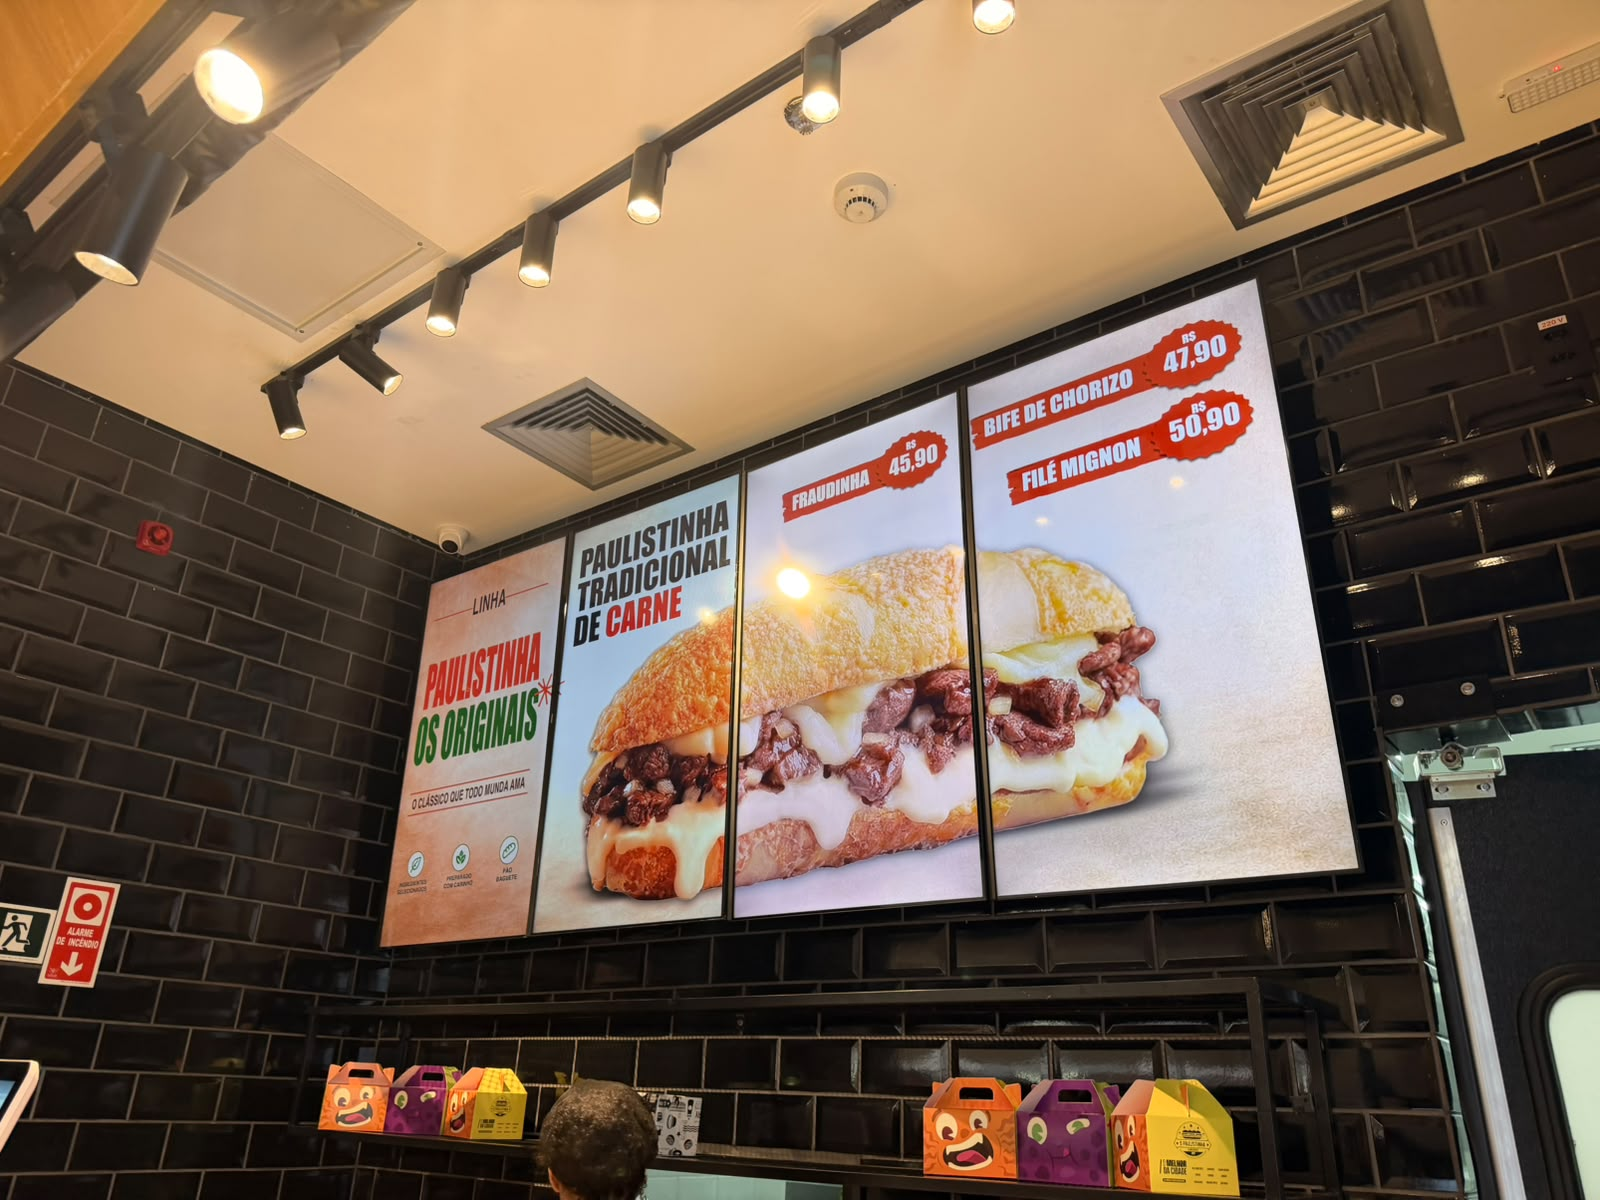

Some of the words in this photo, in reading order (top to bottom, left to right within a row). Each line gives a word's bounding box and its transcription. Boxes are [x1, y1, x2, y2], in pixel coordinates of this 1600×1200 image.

[1163, 334, 1227, 373] 47,90
[1182, 330, 1196, 344] R$
[983, 410, 1021, 438] BIFE
[1024, 398, 1046, 424] DE
[1050, 368, 1133, 414] CHORIZO
[1191, 400, 1206, 414] R$
[1168, 401, 1241, 443] 50,90
[889, 444, 938, 476] 45,90
[906, 439, 917, 451] R$
[1022, 459, 1057, 492] FILÉ
[1061, 436, 1141, 479] MIGNON
[792, 469, 870, 511] FRAUDINHA
[579, 500, 729, 579] PAULISTINHA
[578, 535, 731, 612] TRADICIONAL
[472, 588, 506, 615] LINHA
[573, 610, 601, 647] DE
[605, 585, 683, 638] CARNE
[423, 632, 542, 711] PAULISTINHA
[414, 714, 440, 766] OS
[441, 687, 539, 760] ORIGINAIS
[411, 799, 418, 810] O
[418, 793, 449, 809] CLÁSSICO
[449, 789, 464, 803] QUE
[465, 785, 483, 799] TODO
[484, 779, 509, 795] MUNDA
[510, 776, 525, 790] AMA
[446, 873, 473, 881] PREPARADO
[495, 874, 518, 882] BAGUETE
[56, 936, 66, 946] DE
[67, 938, 100, 949] INCÊNDIO
[67, 927, 94, 938] ALARME
